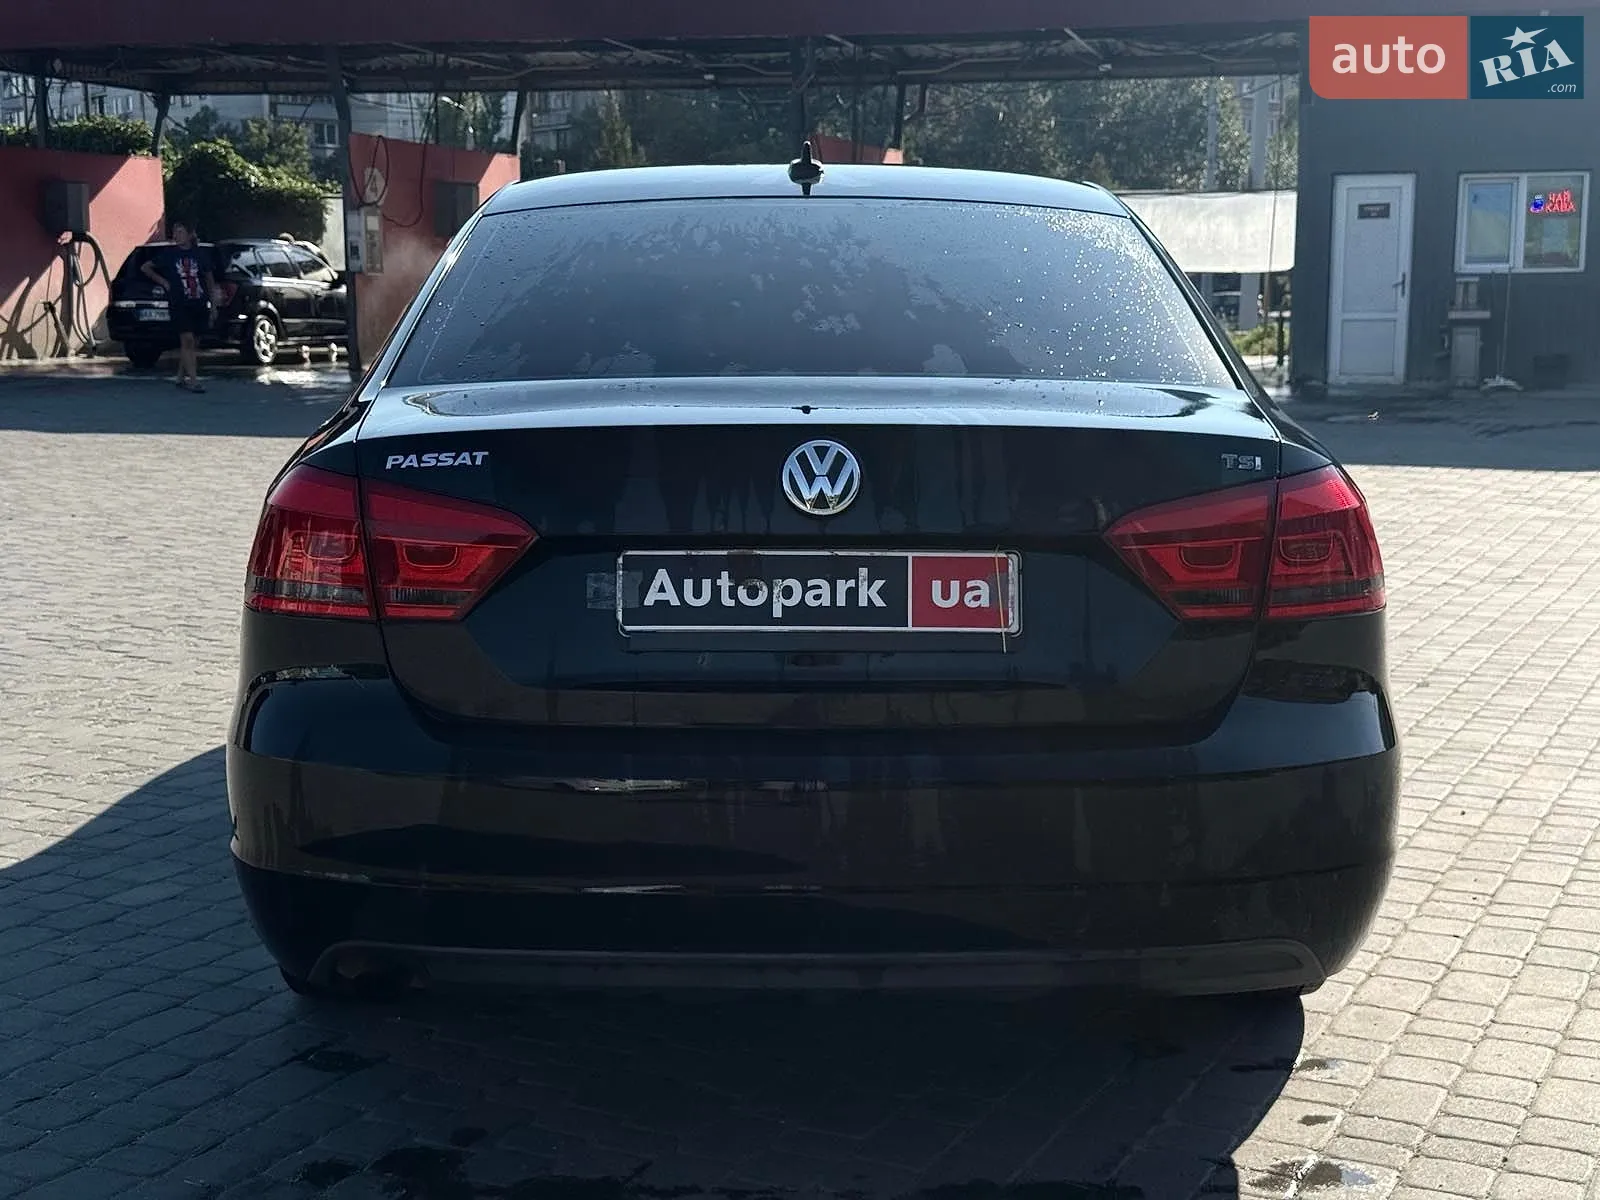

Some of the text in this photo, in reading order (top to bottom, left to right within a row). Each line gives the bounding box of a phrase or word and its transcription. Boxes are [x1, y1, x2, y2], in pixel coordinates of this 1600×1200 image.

[385, 451, 489, 470] PASSAT
[1221, 453, 1262, 470] TSI
[643, 567, 991, 618] Autopark ua
